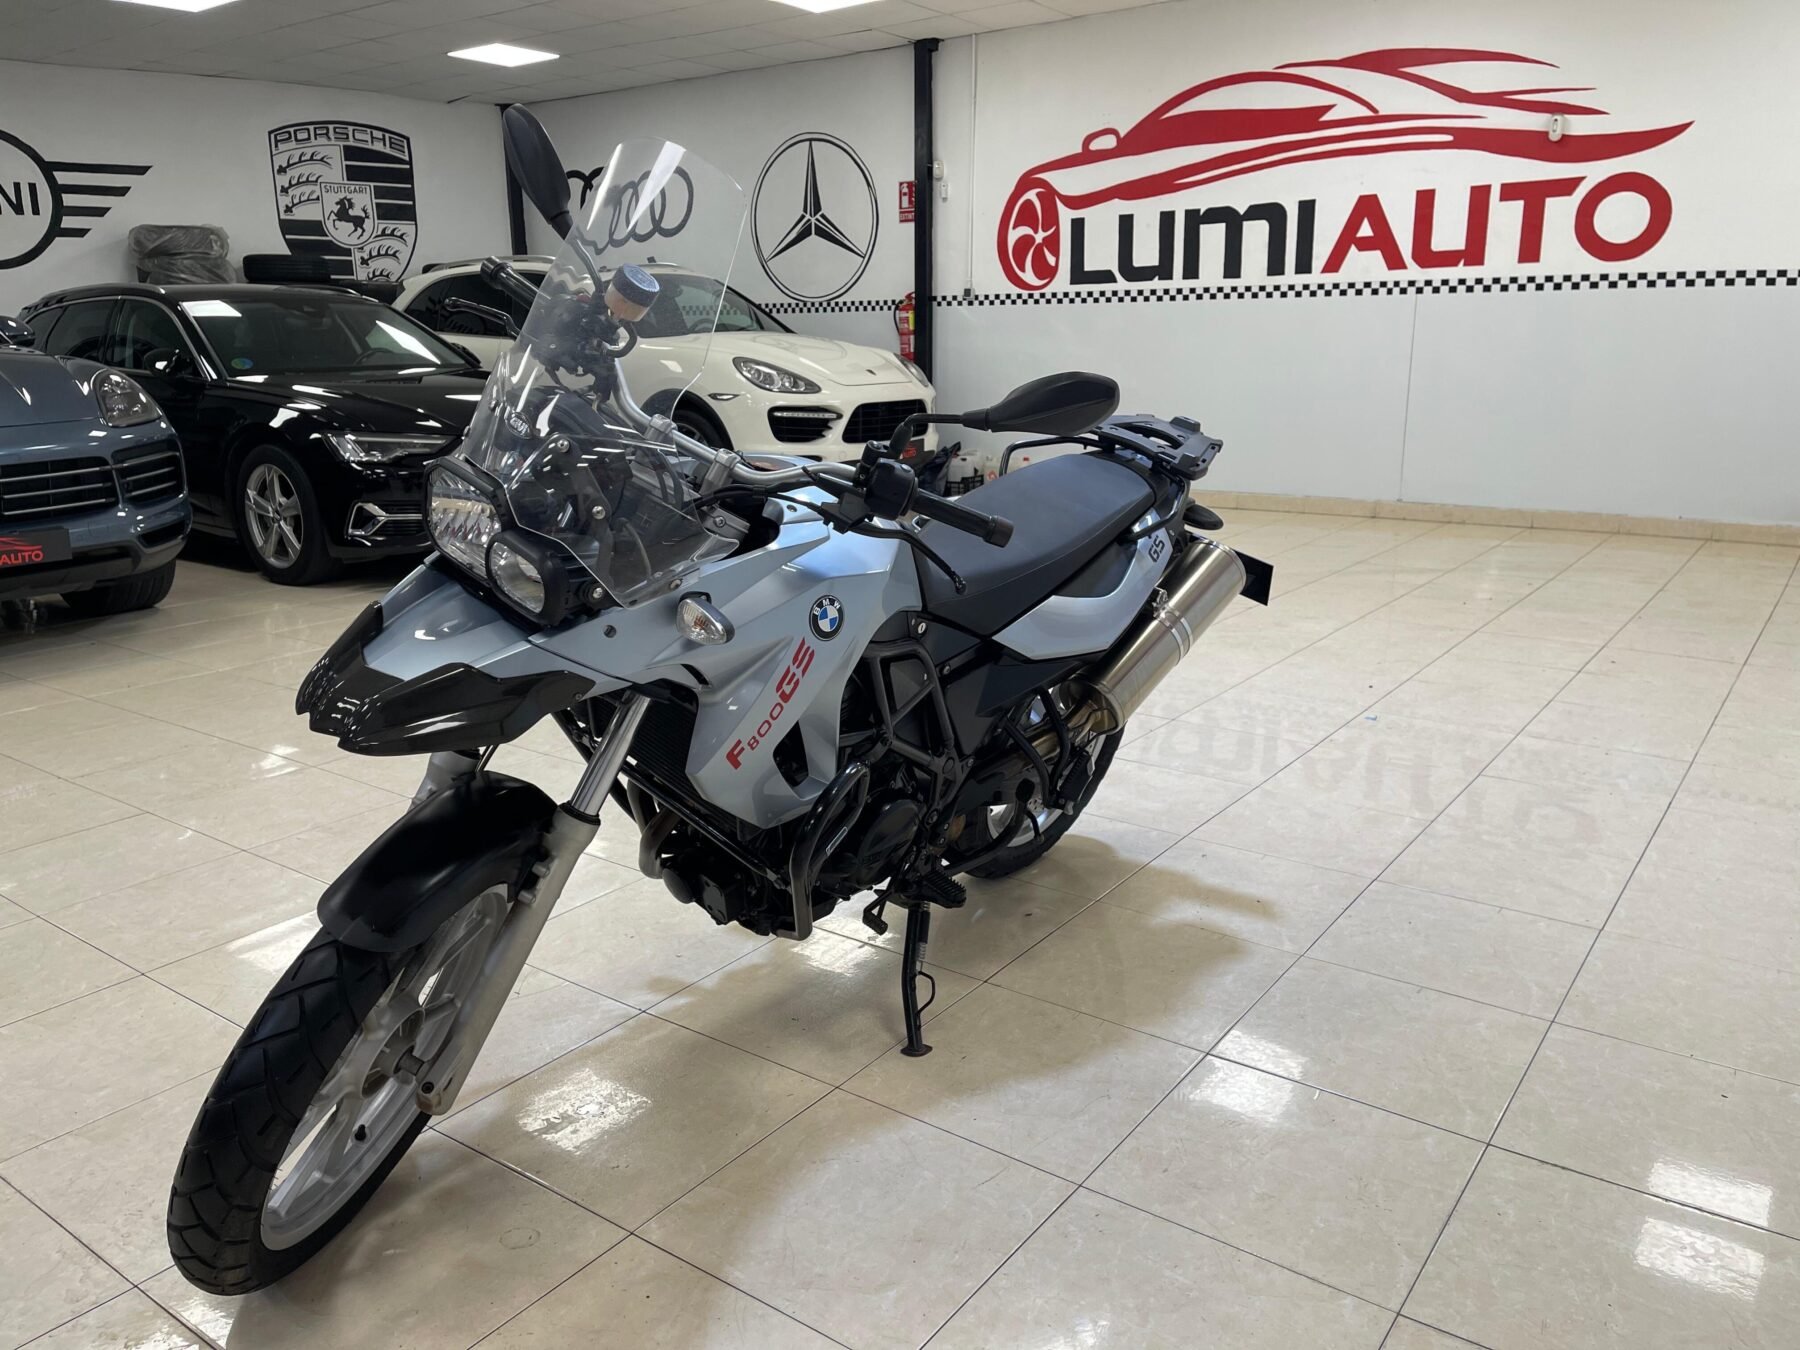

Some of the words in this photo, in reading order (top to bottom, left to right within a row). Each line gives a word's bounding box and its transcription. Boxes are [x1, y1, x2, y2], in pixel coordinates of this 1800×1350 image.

[274, 126, 406, 156] PORSCHE
[324, 185, 368, 195] STUTTGART
[0, 550, 44, 565] AUTO
[1148, 535, 1165, 563] GS
[813, 598, 841, 615] BMW
